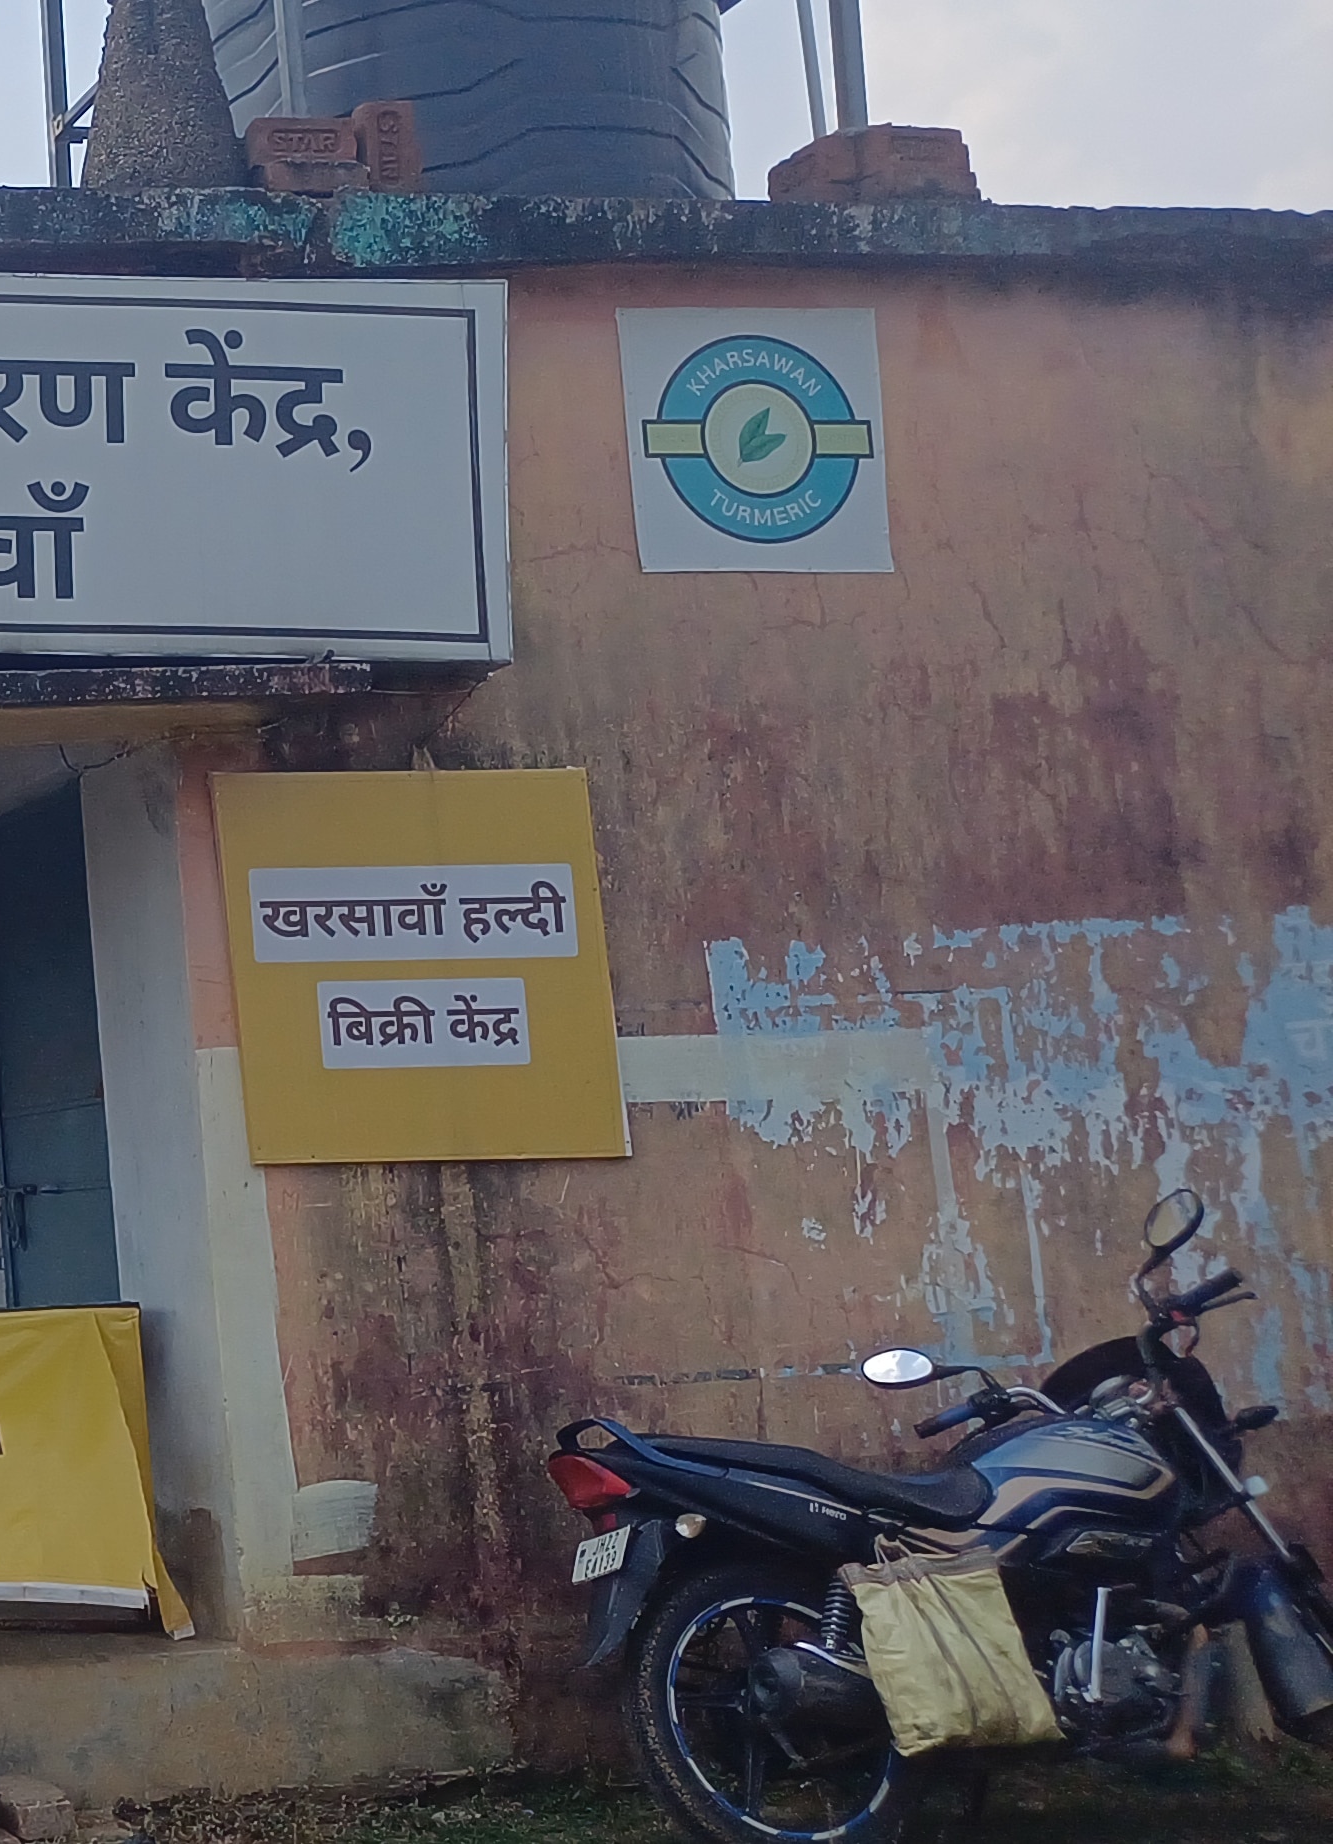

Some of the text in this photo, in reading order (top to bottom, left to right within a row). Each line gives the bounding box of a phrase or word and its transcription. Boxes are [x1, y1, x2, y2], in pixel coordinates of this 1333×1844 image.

[271, 130, 338, 152] STAR
[685, 348, 823, 398] KHARSAWAN
[164, 328, 374, 473] केंद्र,
[708, 488, 823, 528] TURMERIC
[259, 880, 567, 944] खरसावाँ हल्दी
[327, 994, 520, 1048] बिक्री केंद्र
